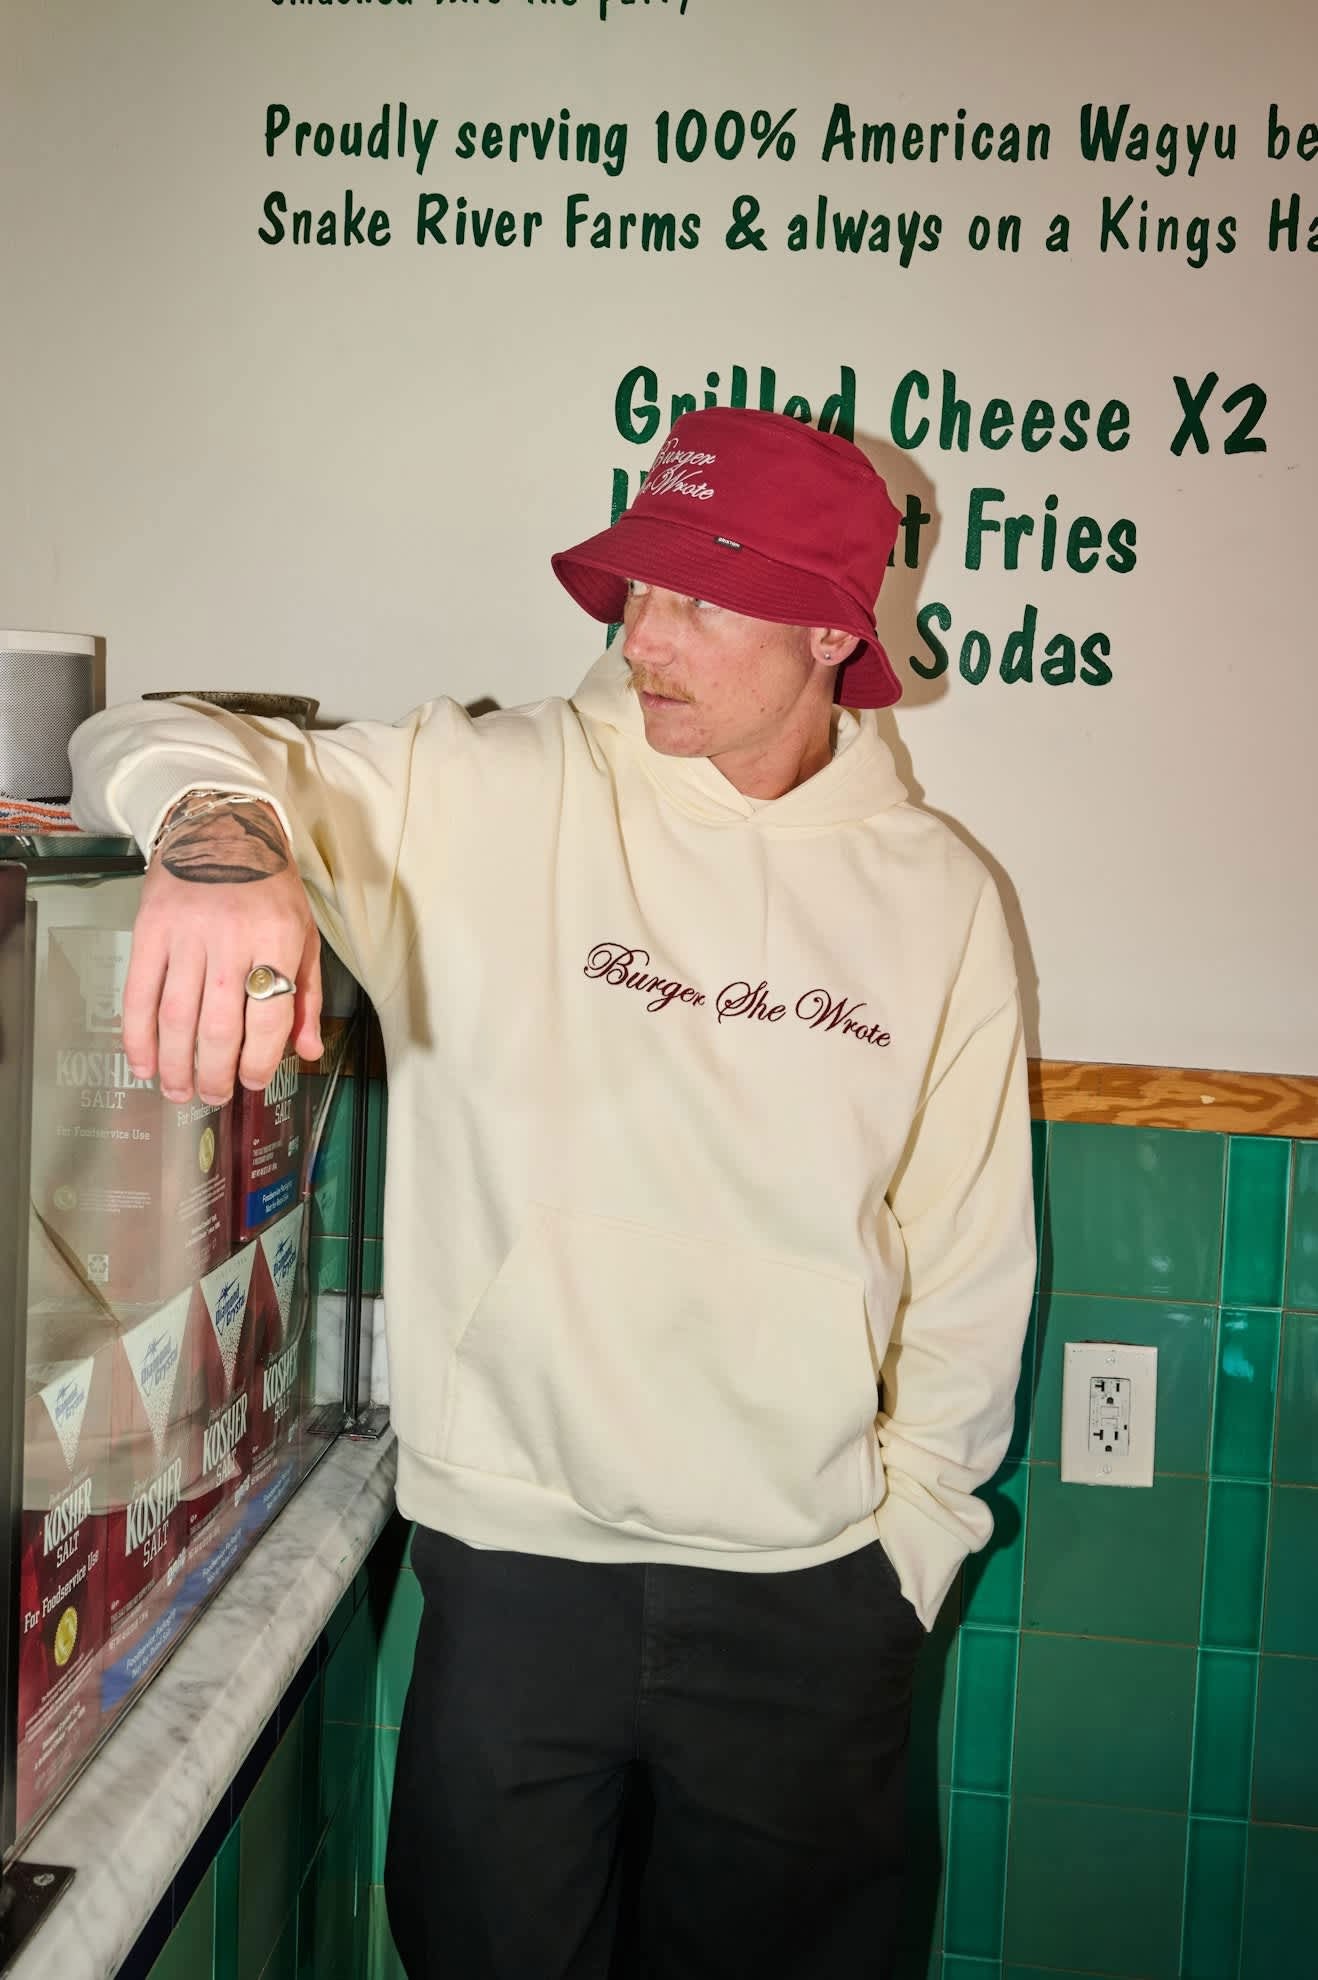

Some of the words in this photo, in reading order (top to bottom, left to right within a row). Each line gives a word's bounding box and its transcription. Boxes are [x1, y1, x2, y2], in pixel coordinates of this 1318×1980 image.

[265, 102, 438, 175] Proudly
[456, 108, 627, 176] serving
[656, 108, 797, 163] 100%
[822, 103, 1050, 164] American
[1081, 104, 1236, 177] Wagyu
[258, 190, 390, 246] Snake
[417, 193, 542, 247] River
[567, 194, 700, 251] Farms
[726, 195, 767, 251] &
[788, 195, 942, 268] always
[969, 215, 1021, 252] on
[1046, 215, 1069, 252] a
[1101, 195, 1236, 268] Kings
[891, 369, 1130, 452] Cheese
[1170, 372, 1267, 456] X2
[965, 488, 1136, 573] Fries
[909, 603, 1112, 686] Sodas
[584, 942, 705, 1013] Burger
[716, 980, 786, 1024] She
[795, 988, 891, 1047] Wrote
[81, 1089, 125, 1109] SALT
[274, 1100, 291, 1125] SALT
[263, 1341, 298, 1412] KOSHER
[202, 1392, 248, 1477] KOSHER
[43, 1478, 92, 1557] KOSHER
[125, 1457, 182, 1557] KOSHER
[143, 1519, 169, 1568] SALT
[56, 1530, 80, 1568] SALT
[24, 1610, 41, 1634] For
[41, 1564, 87, 1619] Foodservice
[87, 1549, 100, 1571] Use
